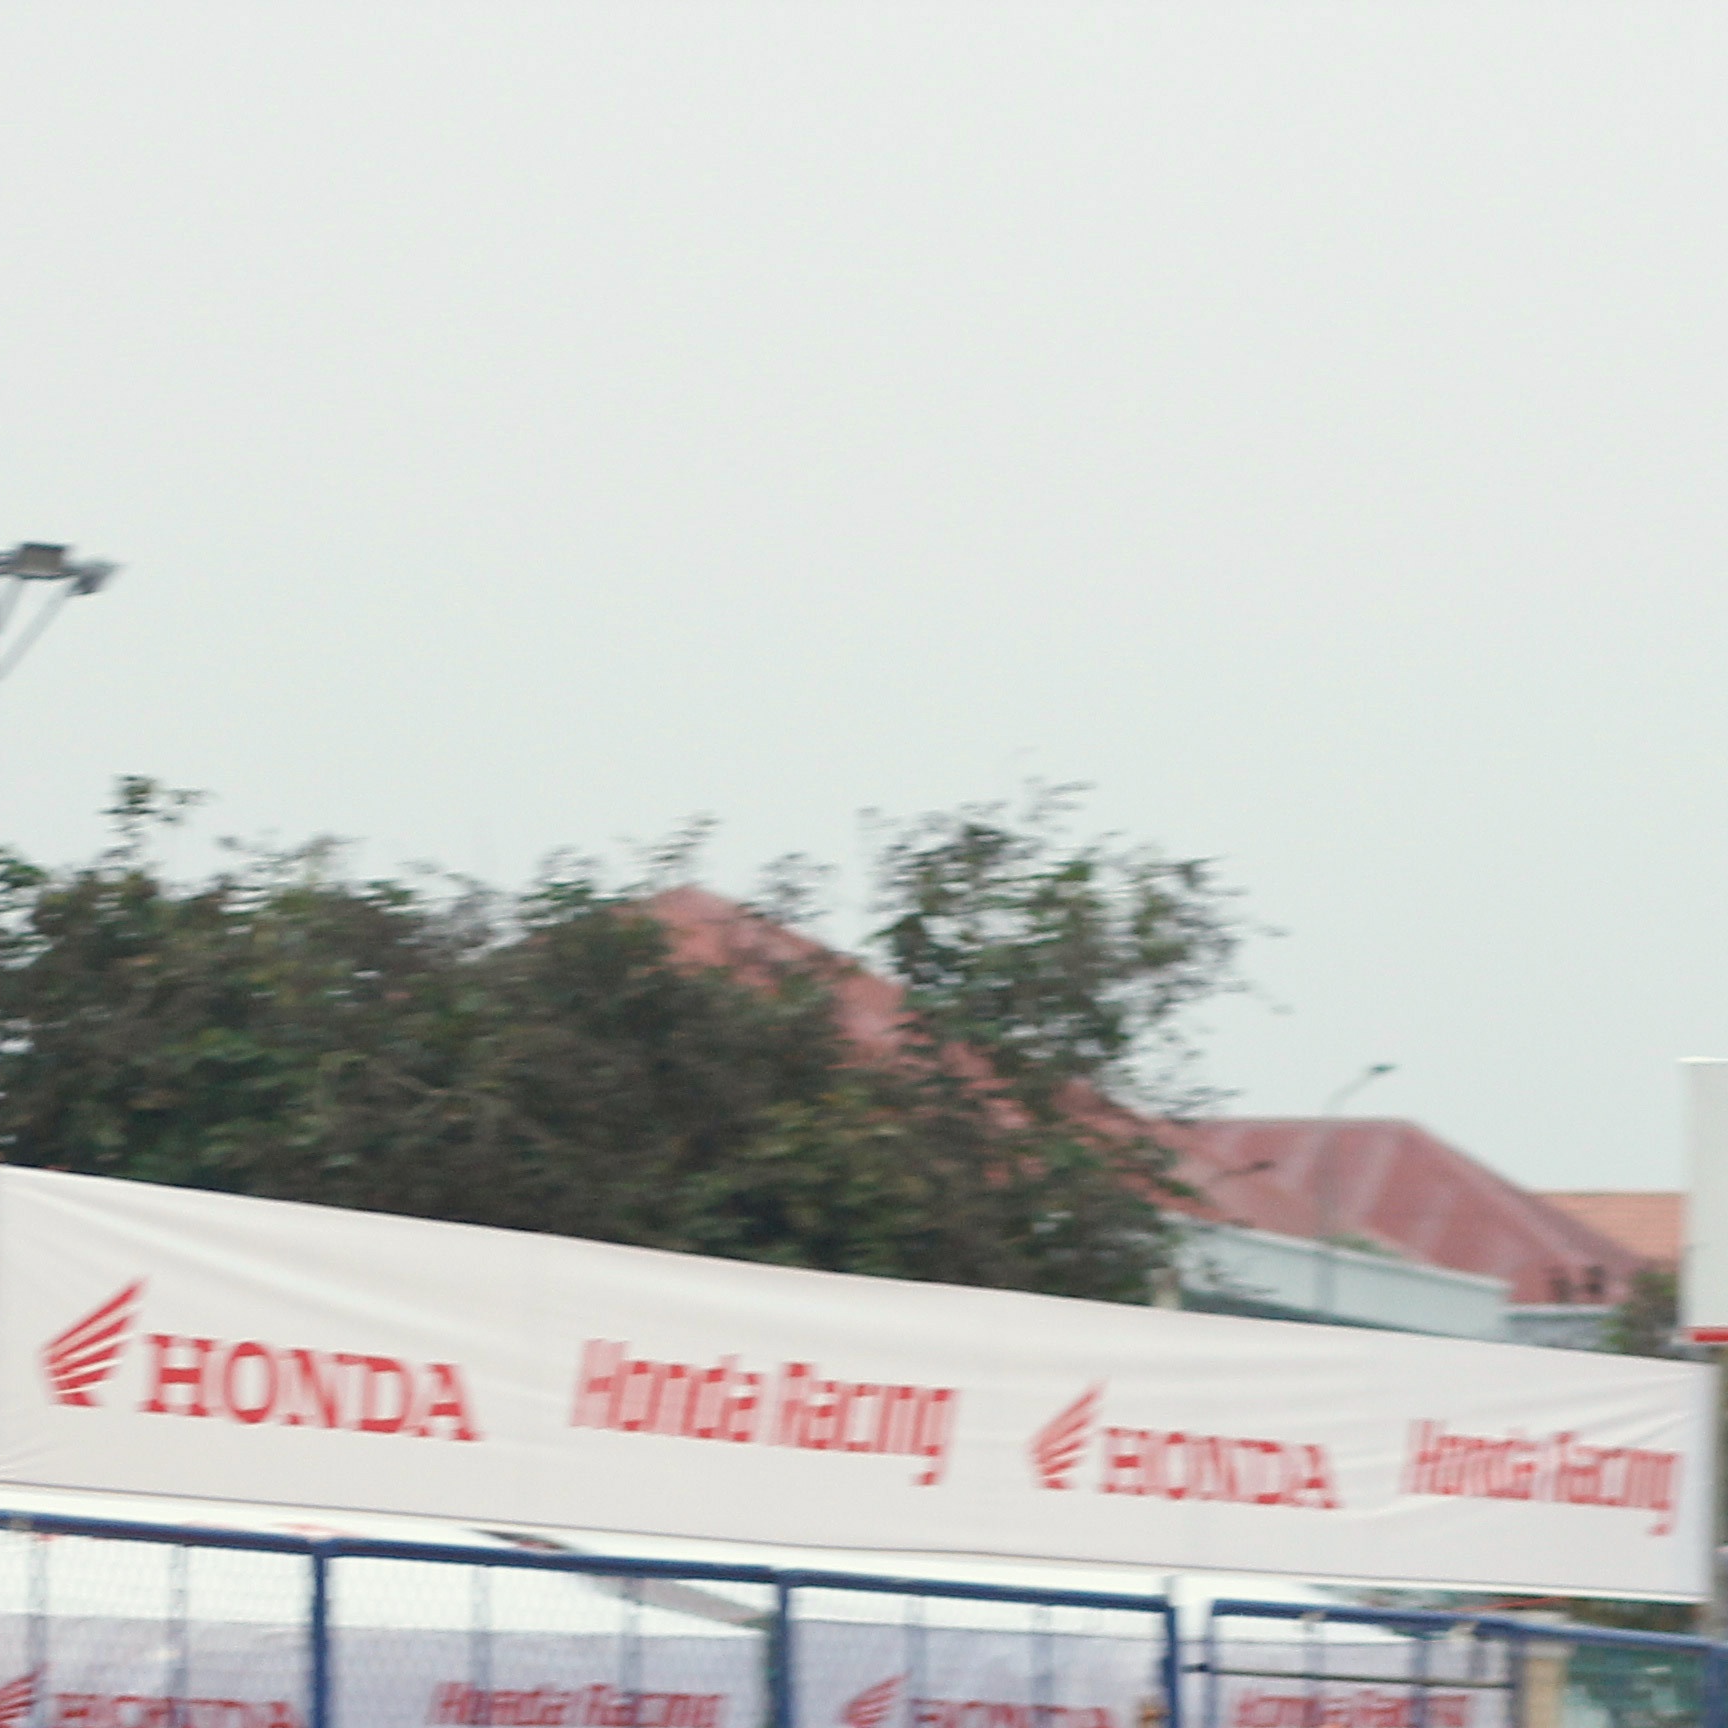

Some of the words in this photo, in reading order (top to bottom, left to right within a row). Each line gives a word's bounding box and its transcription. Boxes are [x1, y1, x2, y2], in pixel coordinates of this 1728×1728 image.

[140, 1332, 484, 1441] HONDA
[570, 1337, 766, 1444] Honda
[770, 1360, 959, 1486] Racing
[1095, 1424, 1343, 1510] HONDA
[1401, 1417, 1548, 1502] Honda
[1551, 1430, 1684, 1537] Racing
